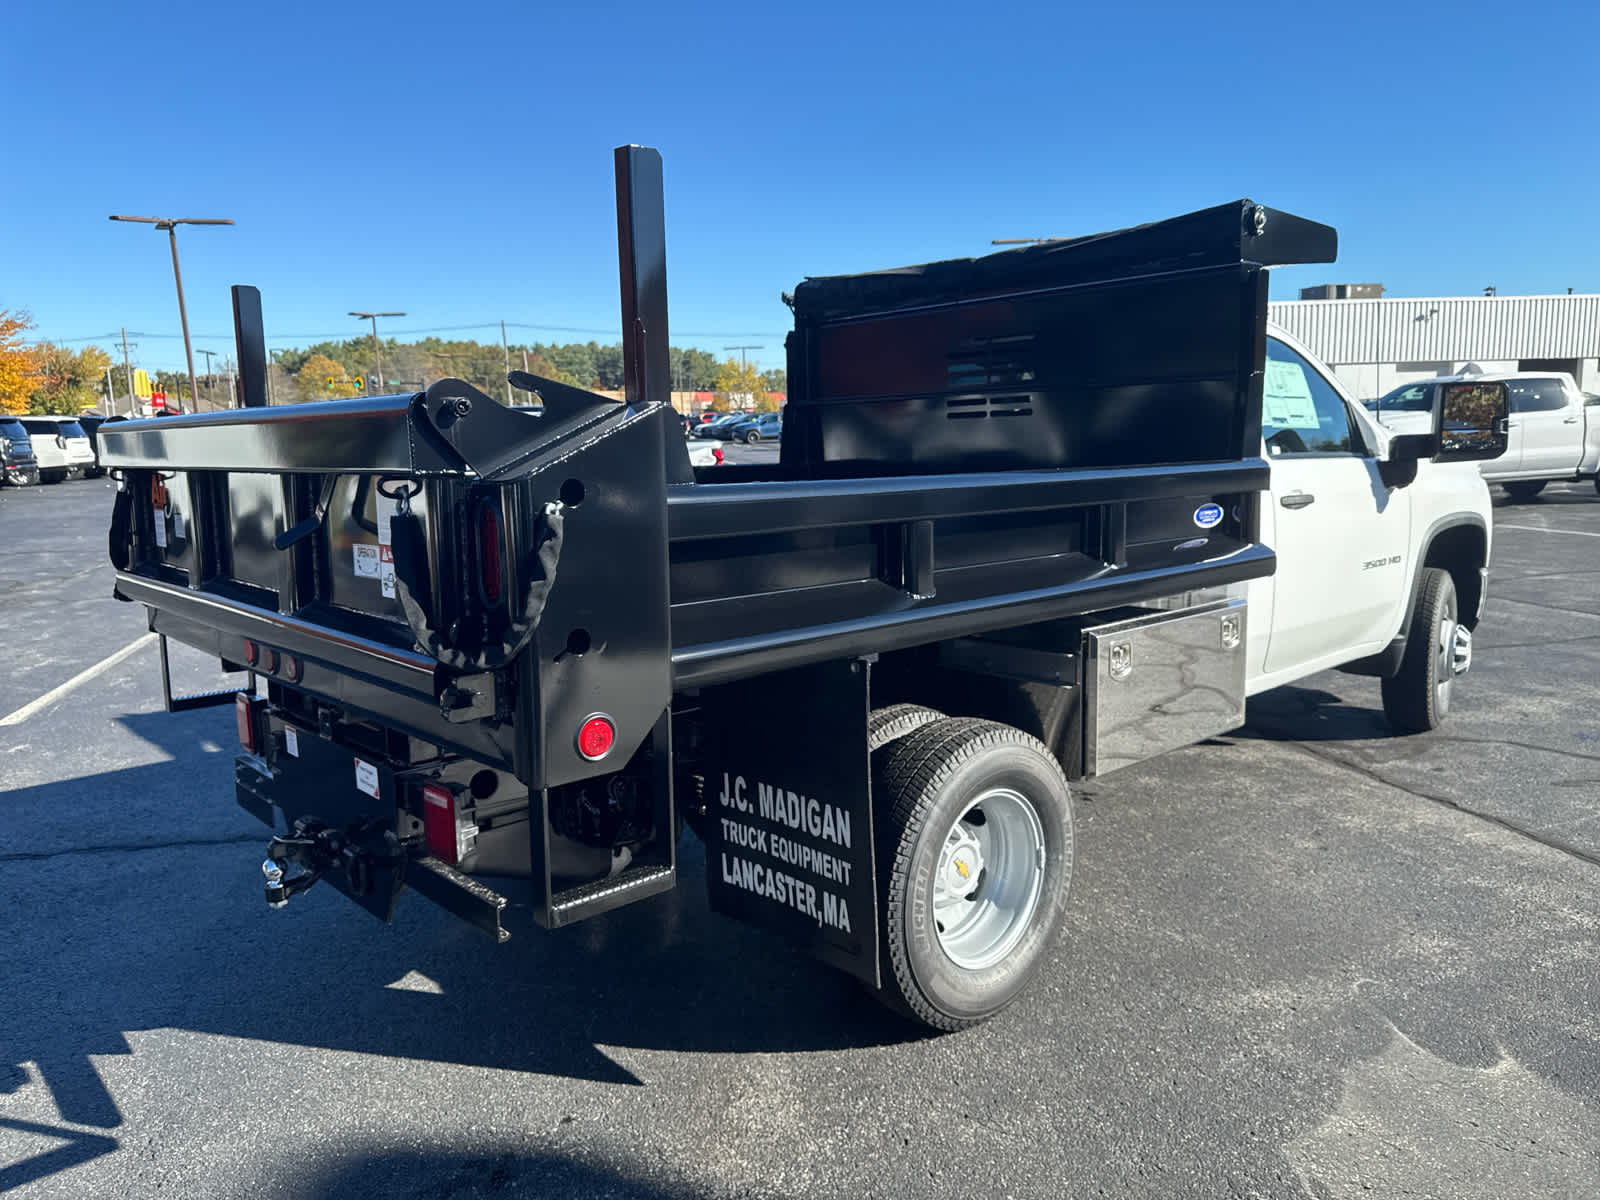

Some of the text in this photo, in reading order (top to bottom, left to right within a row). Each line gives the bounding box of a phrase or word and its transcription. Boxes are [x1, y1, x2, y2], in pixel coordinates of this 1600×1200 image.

[1362, 555, 1401, 571] 3500 HD
[719, 772, 851, 848] J.C. MADIGAN
[720, 817, 851, 886] TRUCK EQUIPMENT
